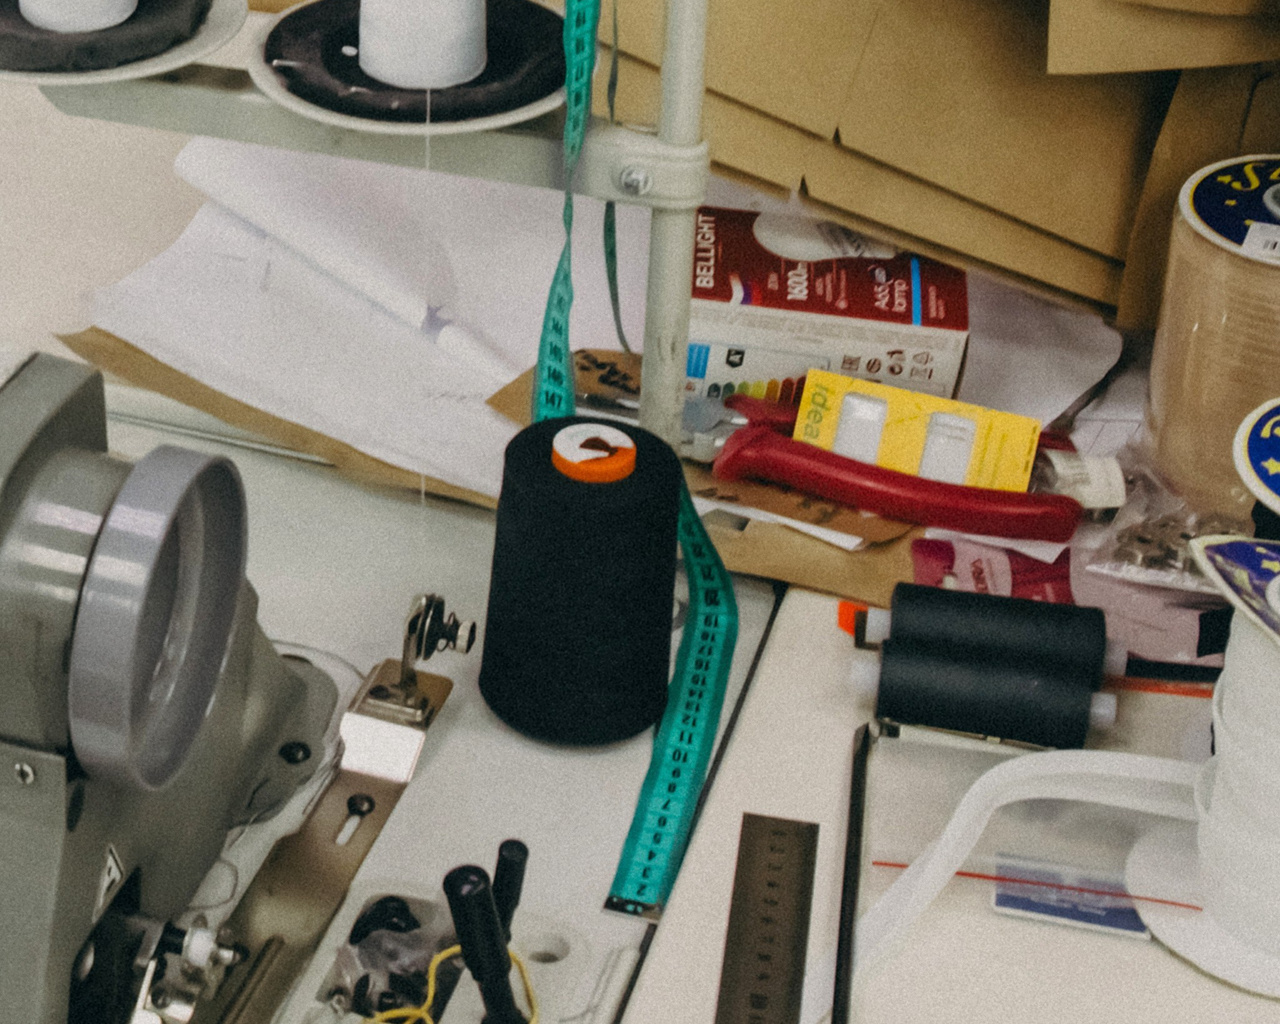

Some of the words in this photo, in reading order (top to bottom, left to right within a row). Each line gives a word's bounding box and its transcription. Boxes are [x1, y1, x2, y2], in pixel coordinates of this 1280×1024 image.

[696, 214, 716, 288] BELLIGHT
[545, 391, 564, 409] 147
[704, 615, 719, 628] 19
[682, 715, 698, 728] 12
[679, 731, 694, 744] 11
[673, 749, 688, 763] 10
[661, 799, 671, 810] 7
[648, 850, 657, 862] 4
[642, 867, 652, 879] 3
[637, 884, 647, 897] 2
